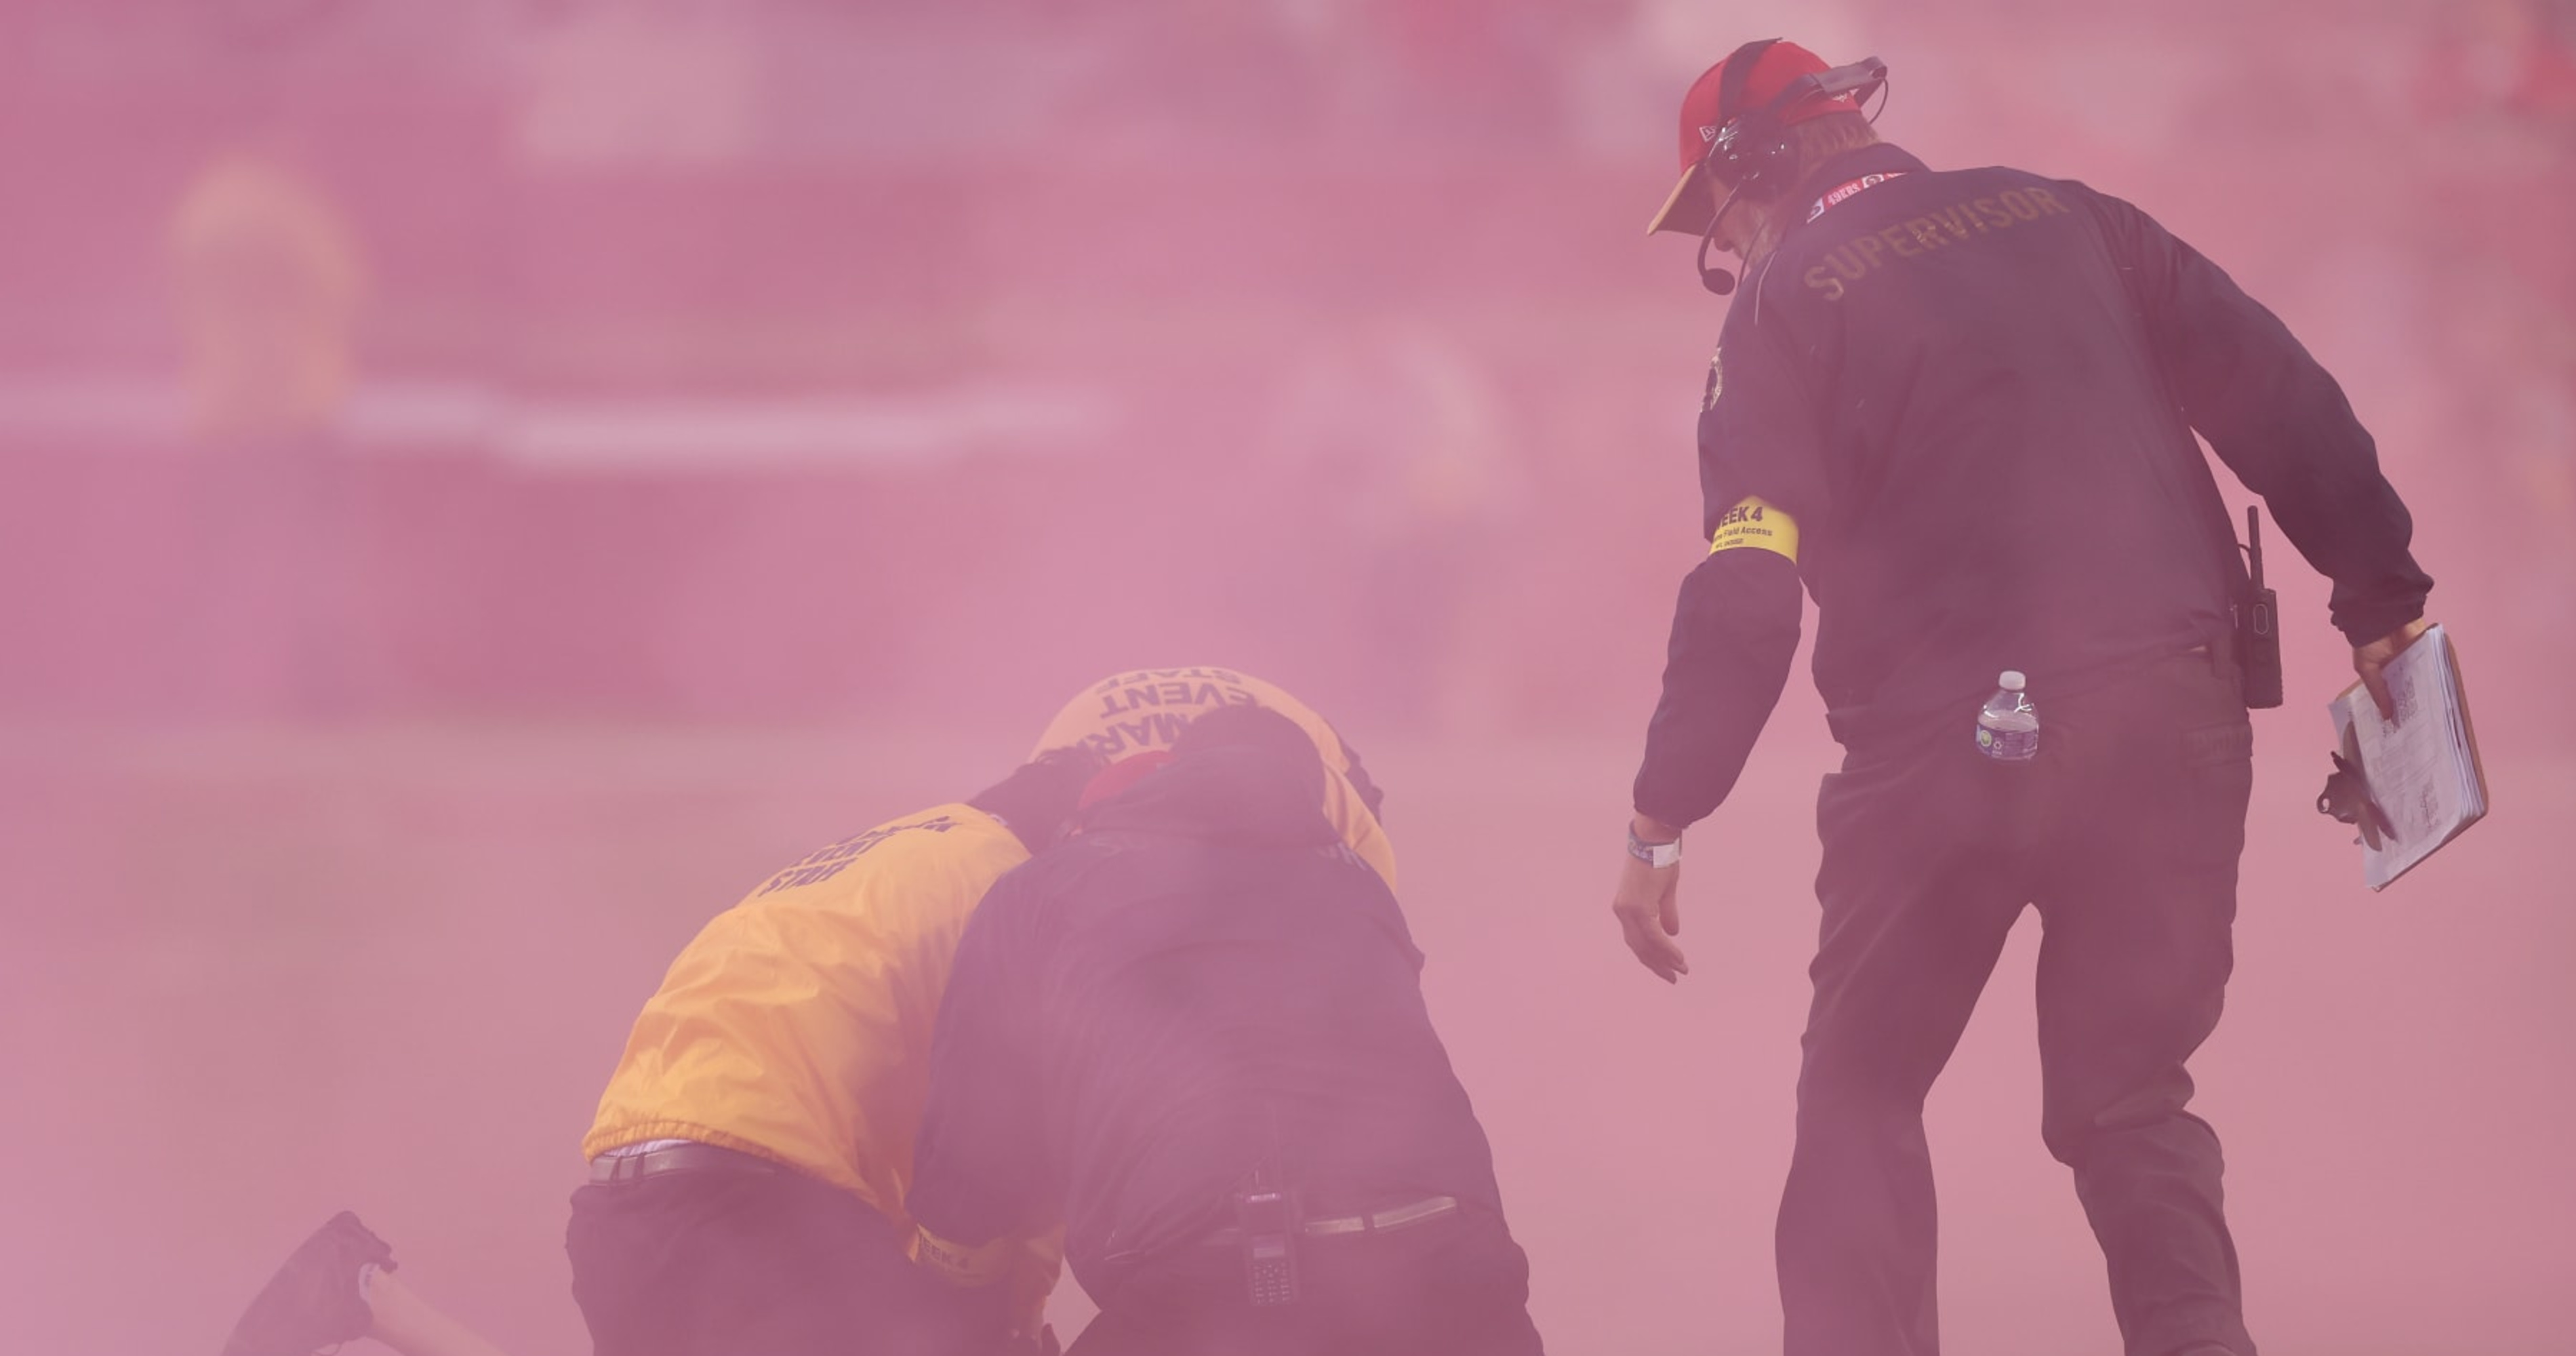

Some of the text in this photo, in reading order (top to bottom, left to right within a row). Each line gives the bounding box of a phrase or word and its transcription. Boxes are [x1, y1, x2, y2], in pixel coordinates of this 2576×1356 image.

[1826, 183, 1861, 206] 49ERS
[1803, 186, 2072, 302] SUPERVISOR
[1720, 506, 1763, 527] EEK 4
[1095, 669, 1242, 694] STAFF
[1098, 681, 1258, 719] EVENT
[919, 1234, 952, 1263] EEK
